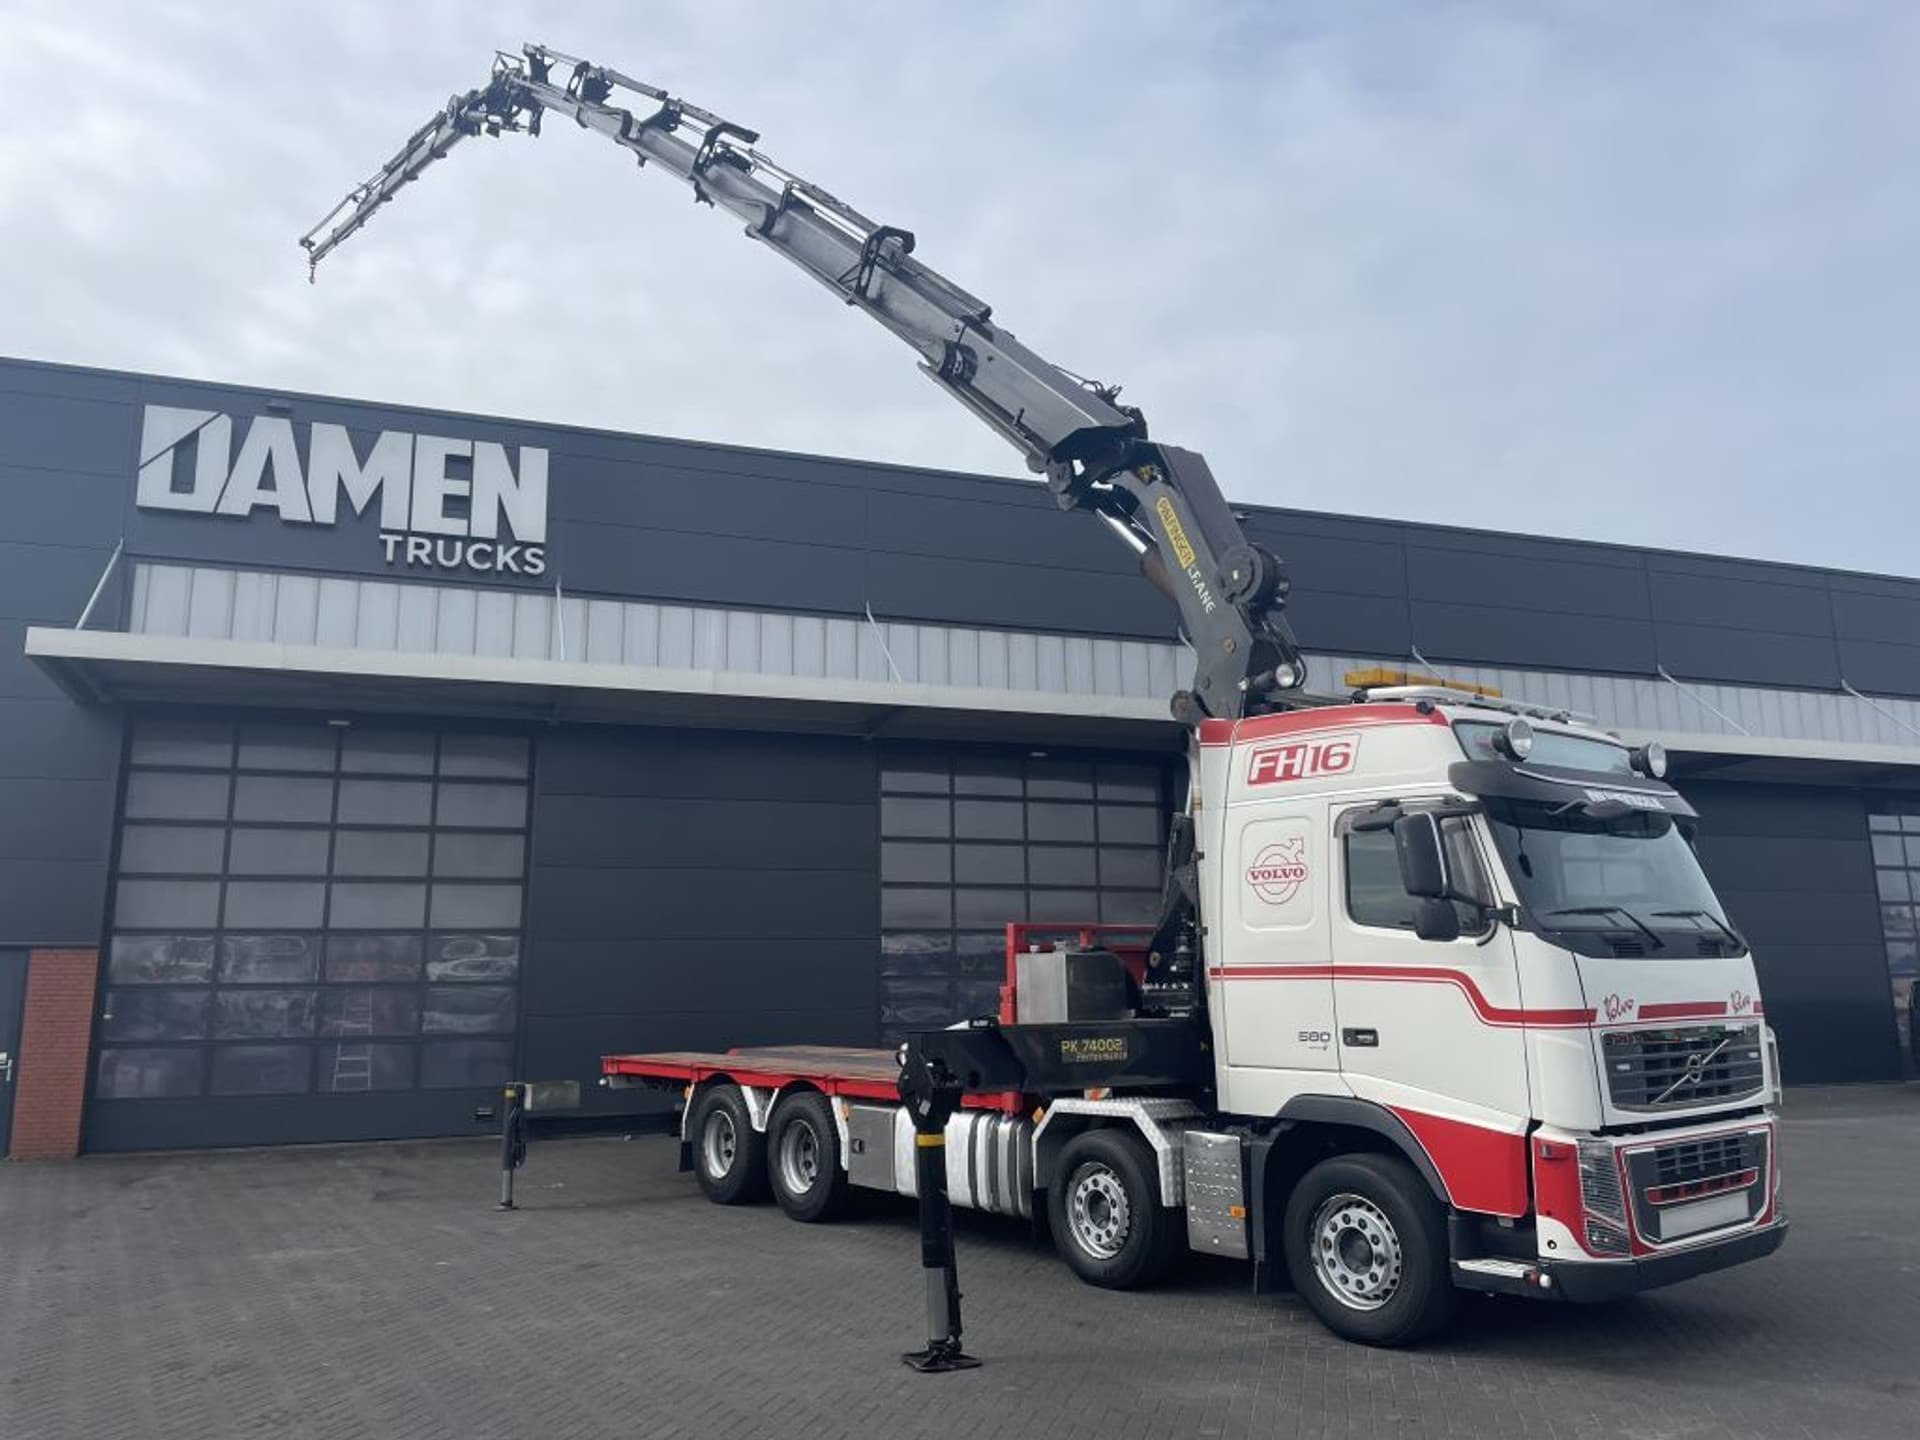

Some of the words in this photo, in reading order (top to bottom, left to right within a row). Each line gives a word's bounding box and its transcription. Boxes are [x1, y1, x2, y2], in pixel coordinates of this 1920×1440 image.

[136, 405, 548, 543] DAMEN
[379, 533, 546, 576] TRUCKS
[1249, 743, 1351, 783] FH16
[1250, 867, 1305, 880] VOLVO
[1061, 1040, 1078, 1053] PK
[1298, 1031, 1331, 1042] 580
